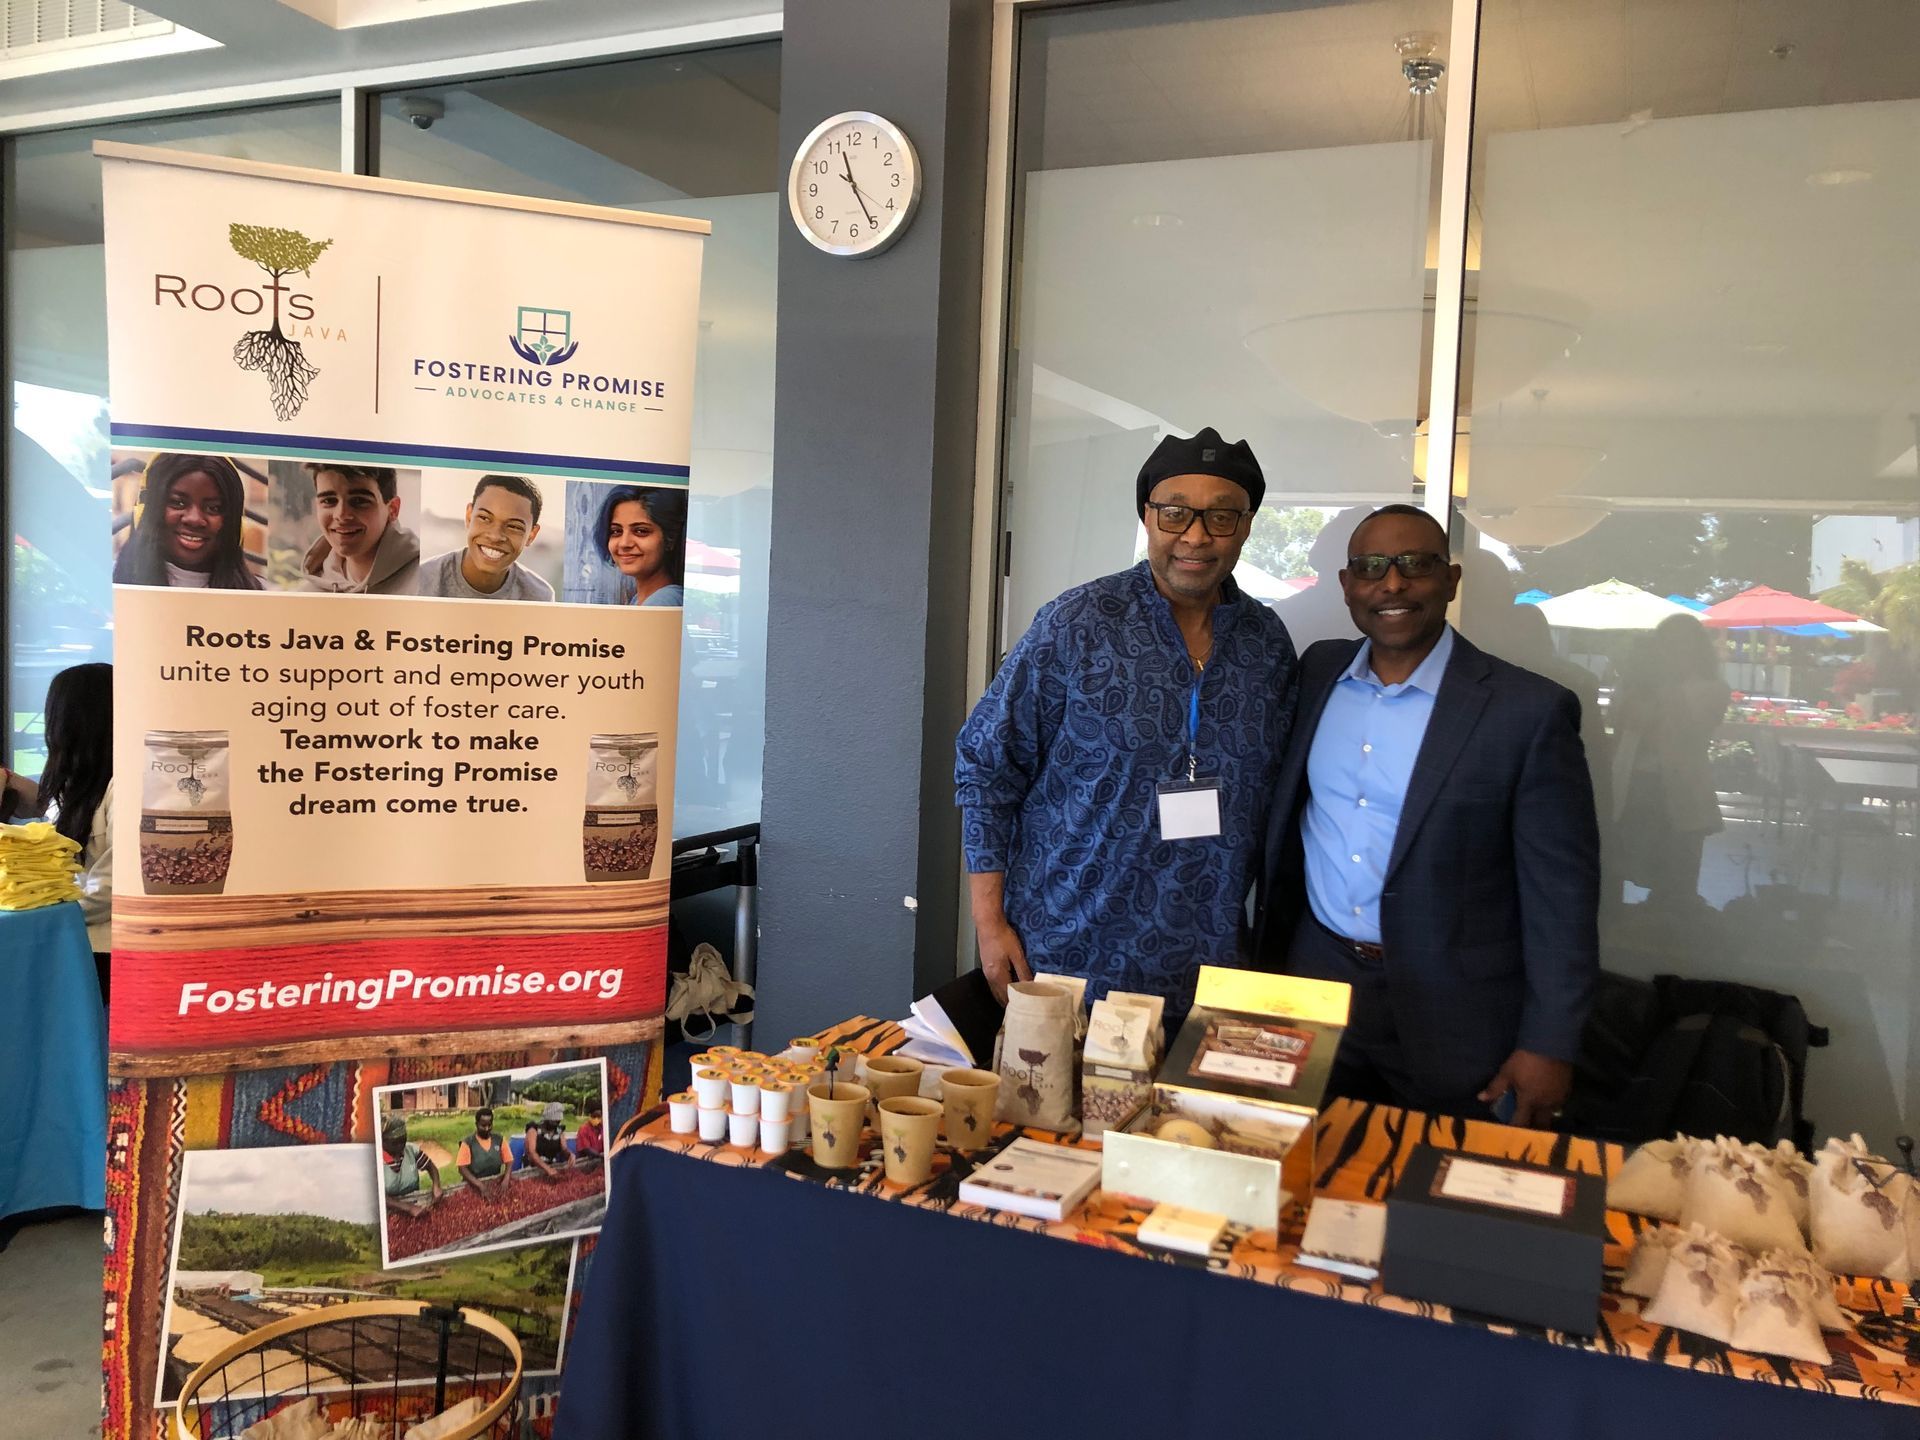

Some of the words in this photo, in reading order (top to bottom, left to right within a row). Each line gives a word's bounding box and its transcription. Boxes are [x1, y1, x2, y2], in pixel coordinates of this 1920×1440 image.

[846, 132, 861, 146] 12
[872, 136, 878, 149] 1
[828, 141, 840, 154] 11
[883, 152, 893, 166] 2
[813, 160, 828, 174] 10
[891, 173, 899, 187] 3
[809, 183, 818, 197] 9
[885, 198, 894, 210] 4
[815, 206, 824, 219] 8
[831, 220, 839, 233] 7
[869, 216, 878, 229] 5
[850, 224, 858, 237] 6
[288, 324, 347, 342] JAVA
[415, 359, 552, 387] FOSTERING
[562, 373, 665, 398] PROMISE
[446, 387, 547, 405] ADVOCATES
[555, 396, 564, 407] 4
[571, 398, 637, 413] CHANGE
[187, 626, 270, 649] Roots
[280, 628, 343, 650] Java
[354, 630, 375, 650] &
[386, 631, 512, 661] Fostering
[524, 636, 625, 658] Promise
[161, 660, 230, 682] unite
[240, 664, 269, 682] to
[280, 666, 383, 690] support
[394, 664, 440, 685] and
[451, 672, 569, 693] empower
[578, 669, 644, 694] youth
[252, 696, 326, 722] aging
[337, 699, 379, 716] out
[390, 696, 416, 716] of
[423, 696, 499, 718] foster
[508, 705, 565, 719] care.
[280, 728, 422, 749] Teamwork
[432, 732, 460, 749] to
[470, 729, 539, 750] make
[257, 761, 303, 783] the
[315, 761, 443, 787] Fostering
[455, 762, 557, 781] Promise
[289, 794, 375, 815] dream
[387, 799, 457, 813] come
[467, 796, 527, 813] true.
[179, 965, 622, 1014] FosteringPromise.org
